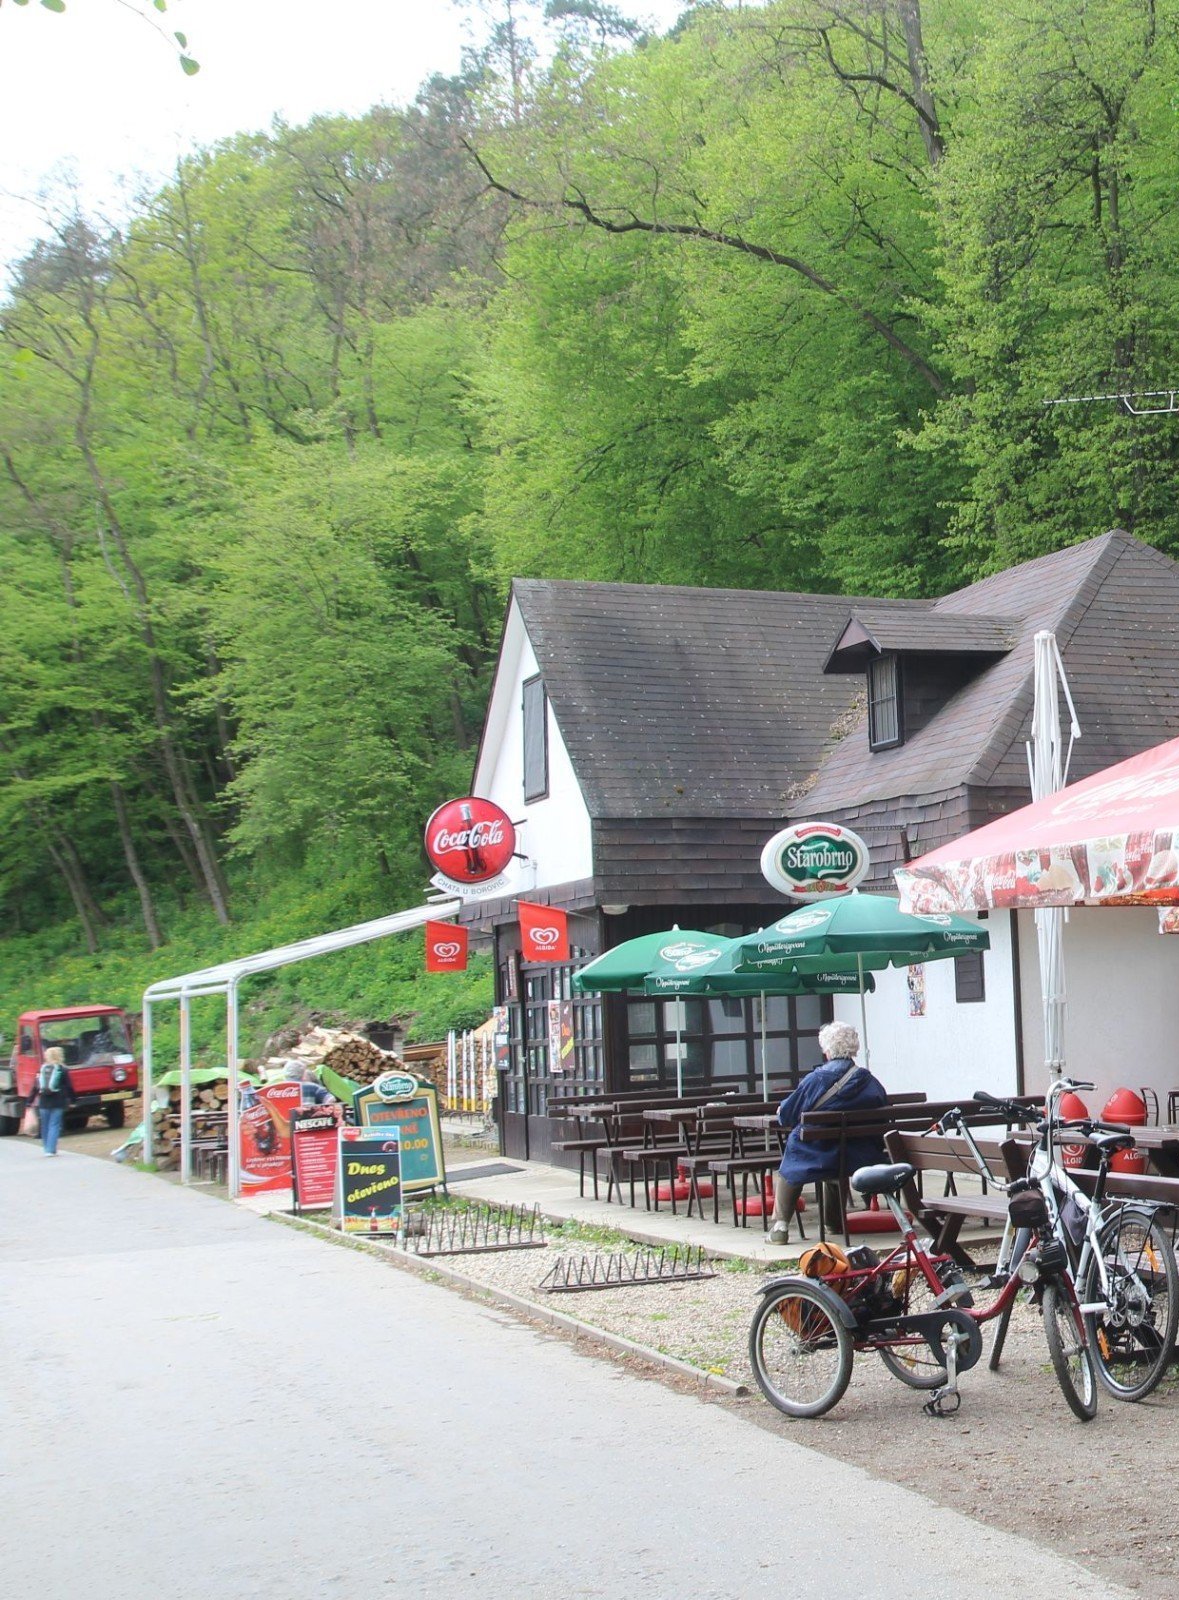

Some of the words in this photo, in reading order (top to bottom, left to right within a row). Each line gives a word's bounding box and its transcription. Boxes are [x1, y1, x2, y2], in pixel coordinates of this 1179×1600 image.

[432, 819, 504, 855] Coca-Cola
[786, 841, 853, 879] Starobrno
[437, 878, 460, 894] CHATA
[462, 887, 469, 895] U
[266, 1086, 300, 1098] Coca-Cola
[347, 1162, 386, 1175] Dnes
[347, 1176, 399, 1203] otevřeno
